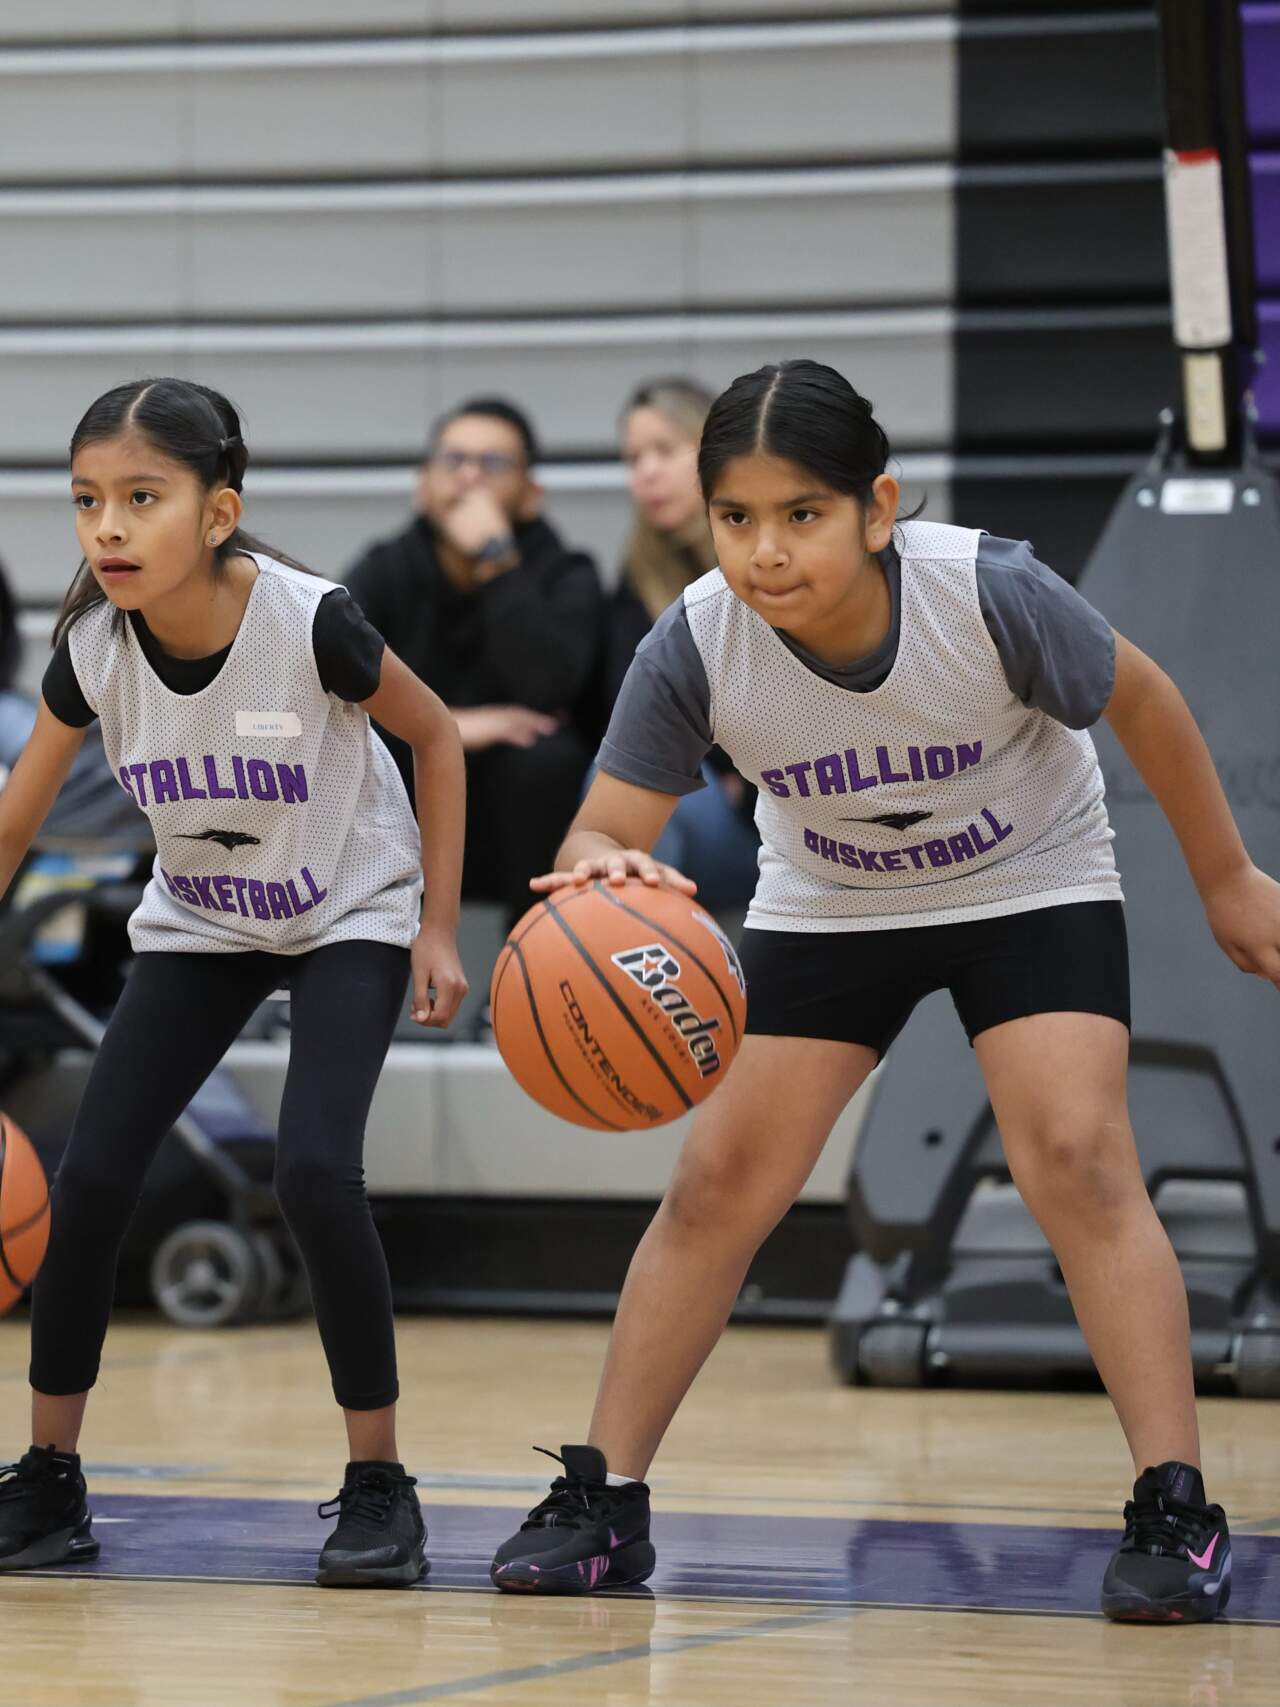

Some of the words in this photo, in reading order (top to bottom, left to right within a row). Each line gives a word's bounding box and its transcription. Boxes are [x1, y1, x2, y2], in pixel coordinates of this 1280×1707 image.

[119, 755, 309, 807] STALLION
[760, 740, 983, 799] STALLION
[803, 807, 1014, 873] BASKETBALL
[160, 866, 328, 921] ASKETBALL
[610, 942, 721, 1080] Baden
